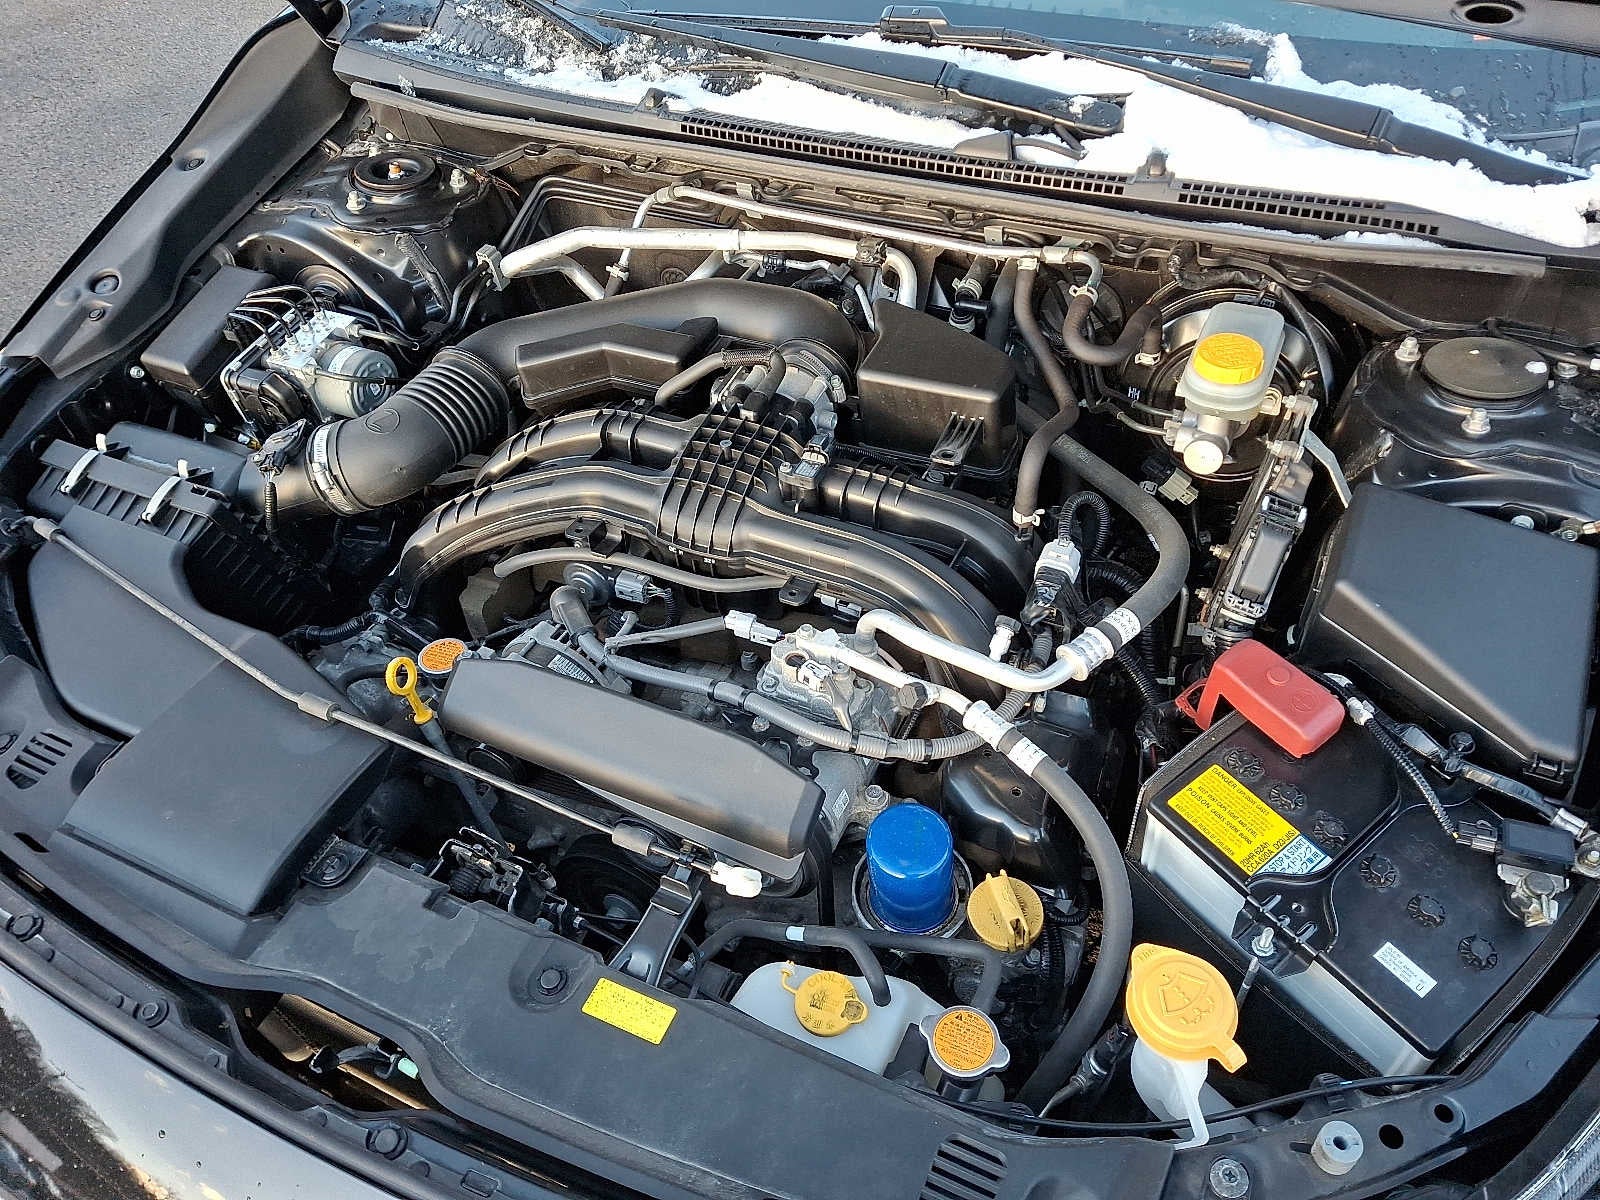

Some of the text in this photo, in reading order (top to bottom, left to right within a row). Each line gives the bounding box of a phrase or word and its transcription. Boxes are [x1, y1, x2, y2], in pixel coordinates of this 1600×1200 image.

[1211, 767, 1238, 790] DANGER
[1186, 787, 1211, 809] POISON
[1269, 856, 1284, 872] STOP
[1287, 838, 1306, 856] START
